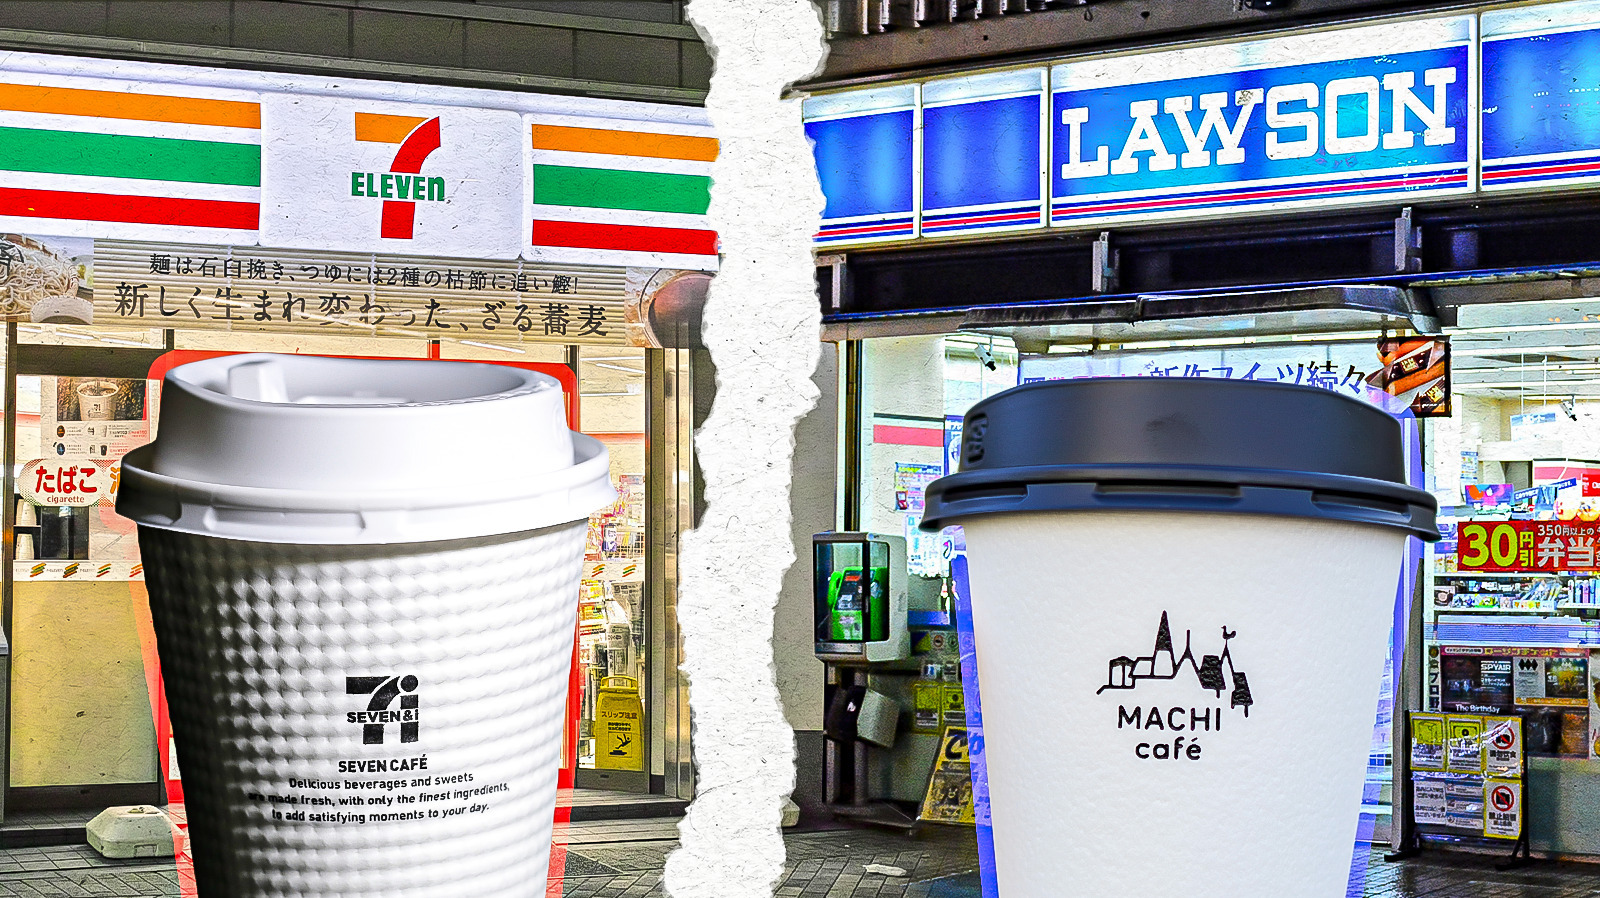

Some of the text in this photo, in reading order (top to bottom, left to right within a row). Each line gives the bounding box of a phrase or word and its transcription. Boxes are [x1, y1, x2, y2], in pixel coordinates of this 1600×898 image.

[1061, 67, 1457, 180] LAWSON
[114, 282, 608, 337] 新しく生まれ変わった、ざる蕎麦
[35, 465, 97, 493] たばこ
[46, 495, 85, 504] cigarette
[1537, 537, 1595, 568] 弁当
[1480, 663, 1511, 671] SPYAIR
[1118, 705, 1220, 731] MACHI
[1456, 704, 1500, 714] The Birthday
[1135, 736, 1201, 760] café
[338, 754, 427, 773] SEVEN CAFÉ
[289, 773, 473, 791] Delicious beverages and sweets
[268, 794, 298, 804] made
[301, 795, 335, 807] fresh,
[339, 796, 364, 806] with
[367, 795, 393, 806] only
[397, 795, 415, 803] the
[419, 791, 450, 802] finest
[453, 782, 510, 800] ingredients,
[272, 803, 489, 824] to add satisfying moments to your day.
